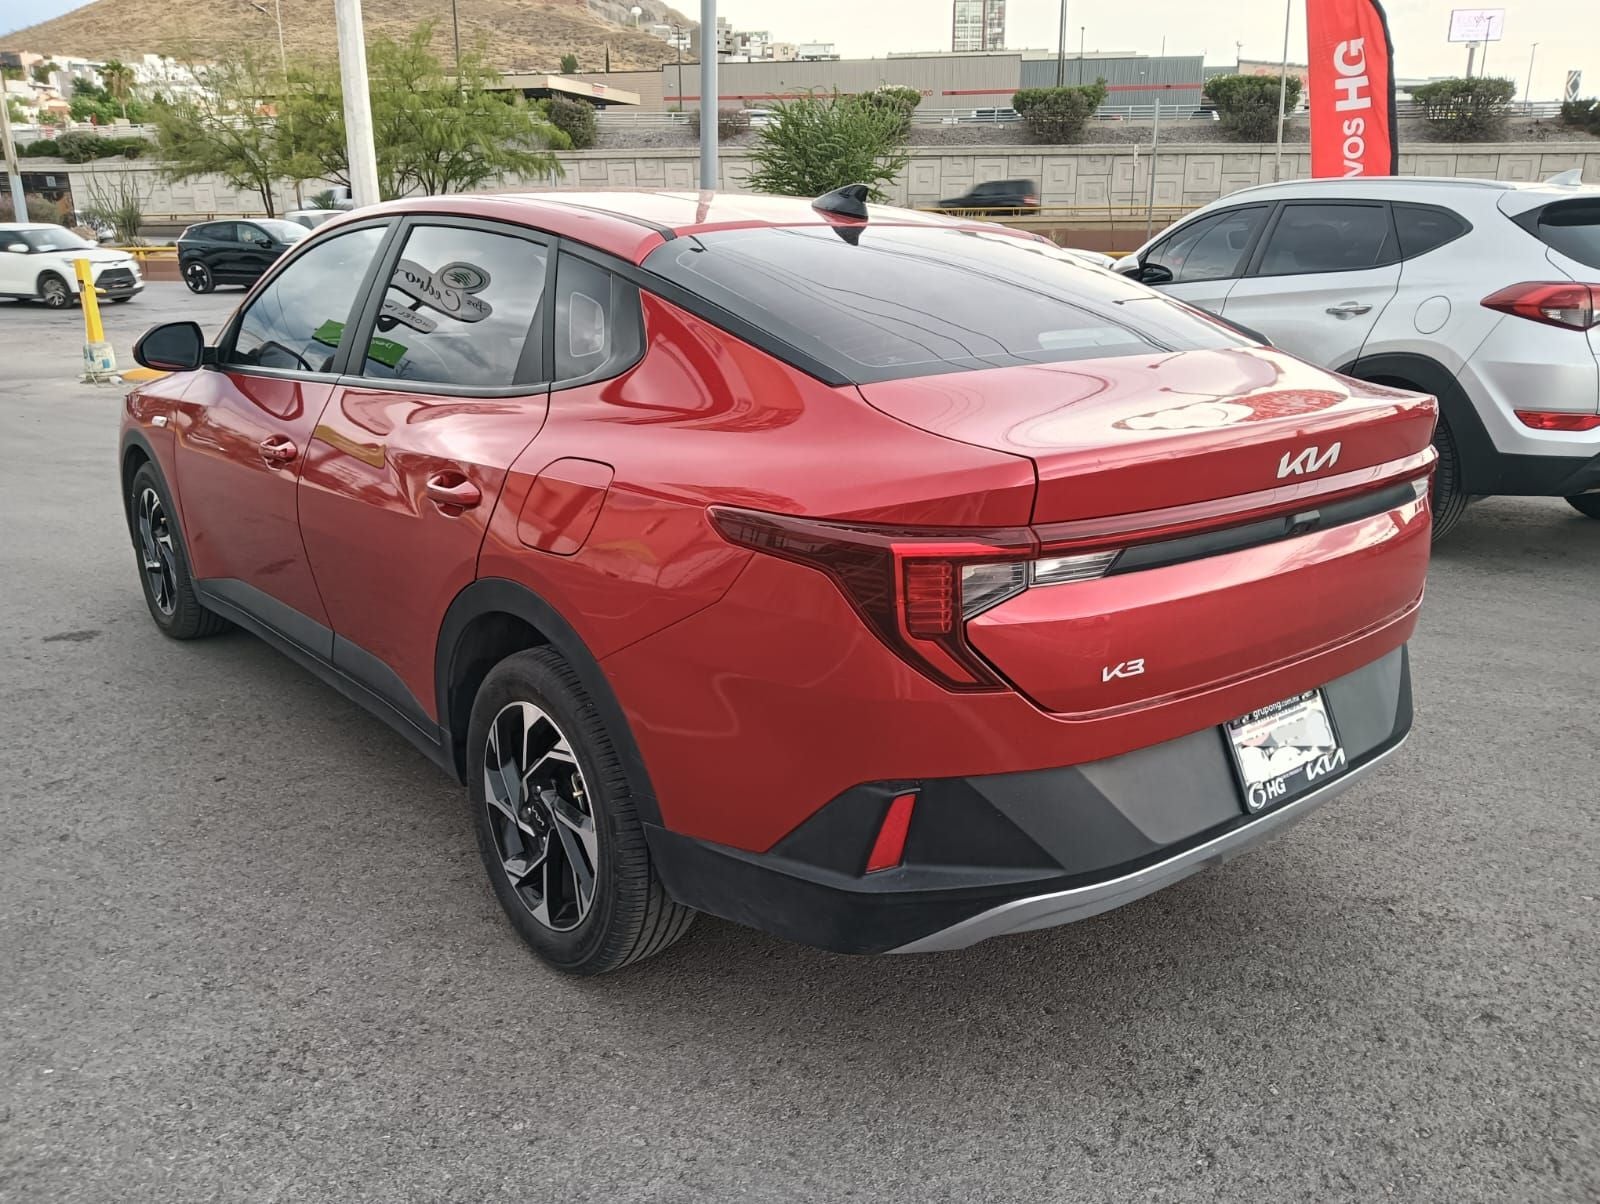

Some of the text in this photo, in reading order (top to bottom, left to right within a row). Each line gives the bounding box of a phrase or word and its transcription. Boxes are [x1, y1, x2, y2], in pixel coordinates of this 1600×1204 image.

[1333, 37, 1372, 112] HG
[1277, 441, 1341, 478] KIA
[1102, 658, 1145, 682] K3
[1266, 777, 1287, 799] HG
[1306, 747, 1346, 780] KIA
